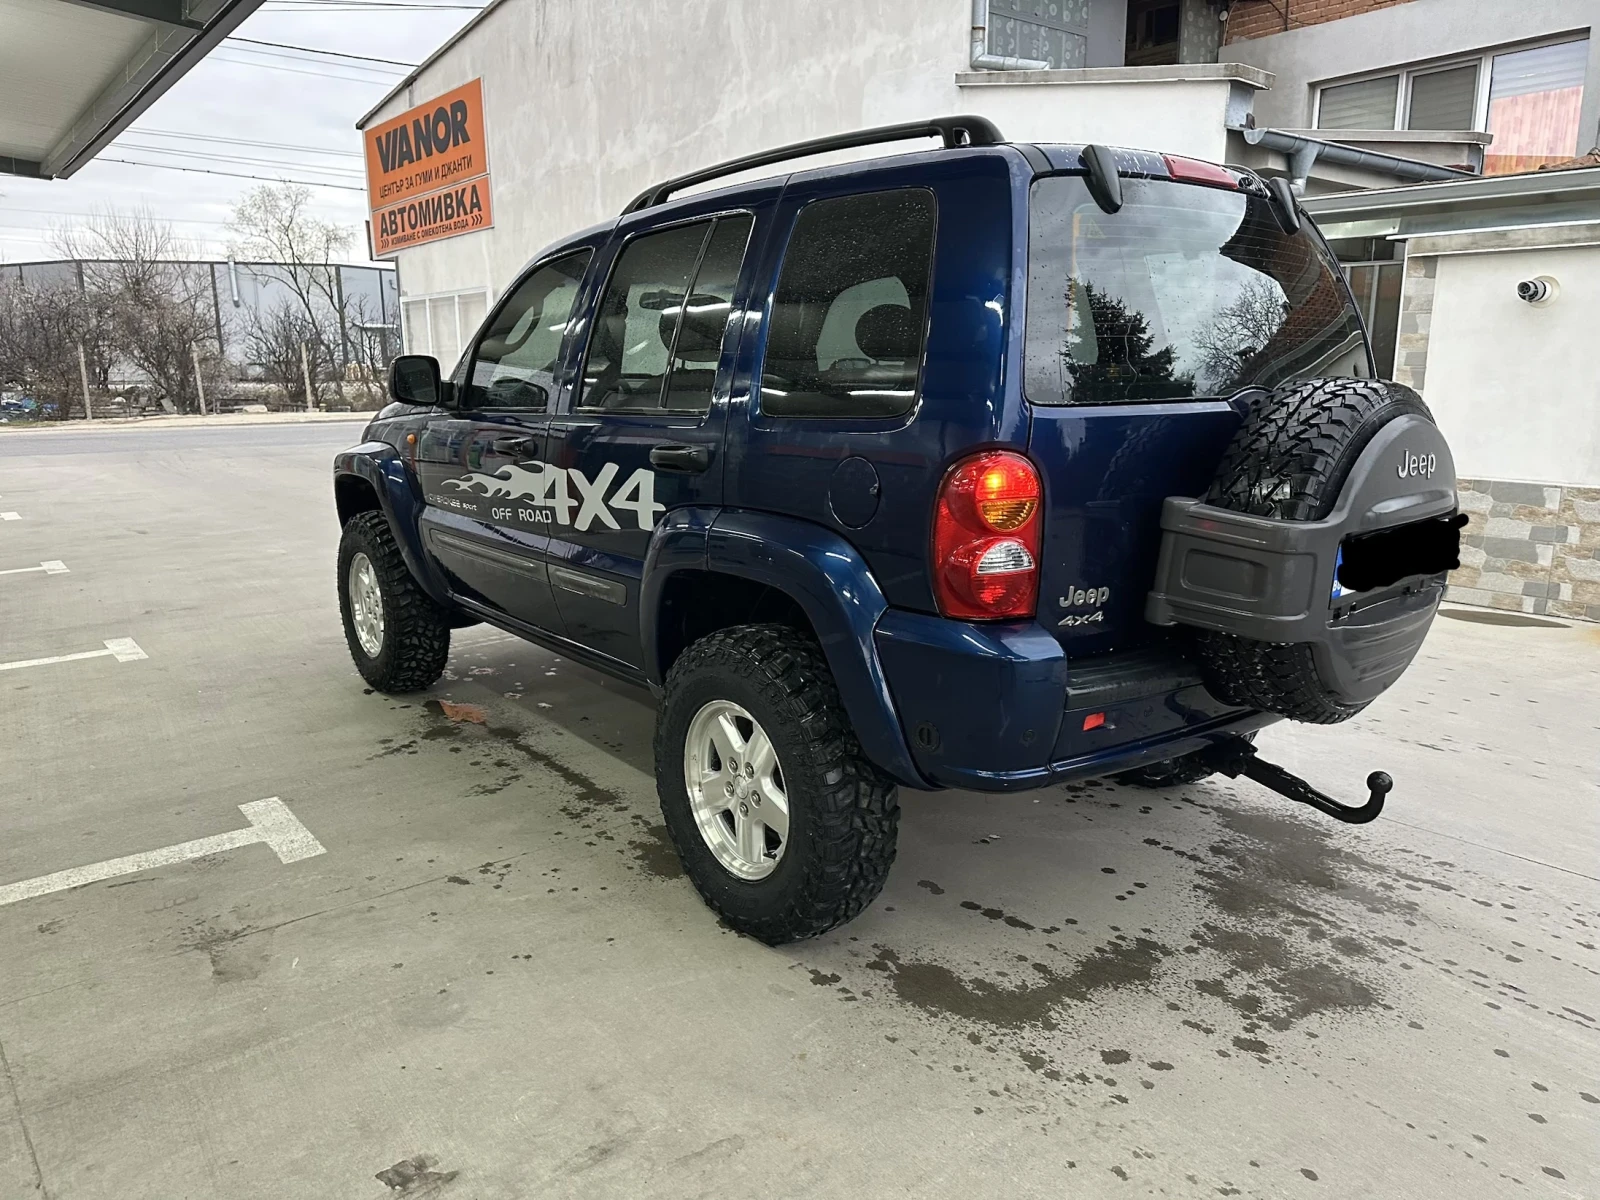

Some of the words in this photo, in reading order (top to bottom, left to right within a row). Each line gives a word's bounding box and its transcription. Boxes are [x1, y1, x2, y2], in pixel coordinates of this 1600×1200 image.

[375, 99, 471, 174] VIANOR
[379, 179, 404, 199] ЦЕНТЪР
[405, 175, 414, 190] ЗА
[415, 168, 433, 187] ГУМИ
[434, 165, 440, 180] И
[441, 154, 473, 180] ДЖАНТИ
[380, 184, 482, 238] АВТОМИВКА
[391, 232, 416, 246] ИЗМИВАНЕ
[421, 223, 453, 238] ОМЕКОТЕНА
[453, 218, 469, 230] ВОДА
[1397, 449, 1436, 479] Jeep
[491, 507, 512, 520] OFF
[518, 508, 552, 523] ROAD
[1058, 585, 1110, 608] Jeep
